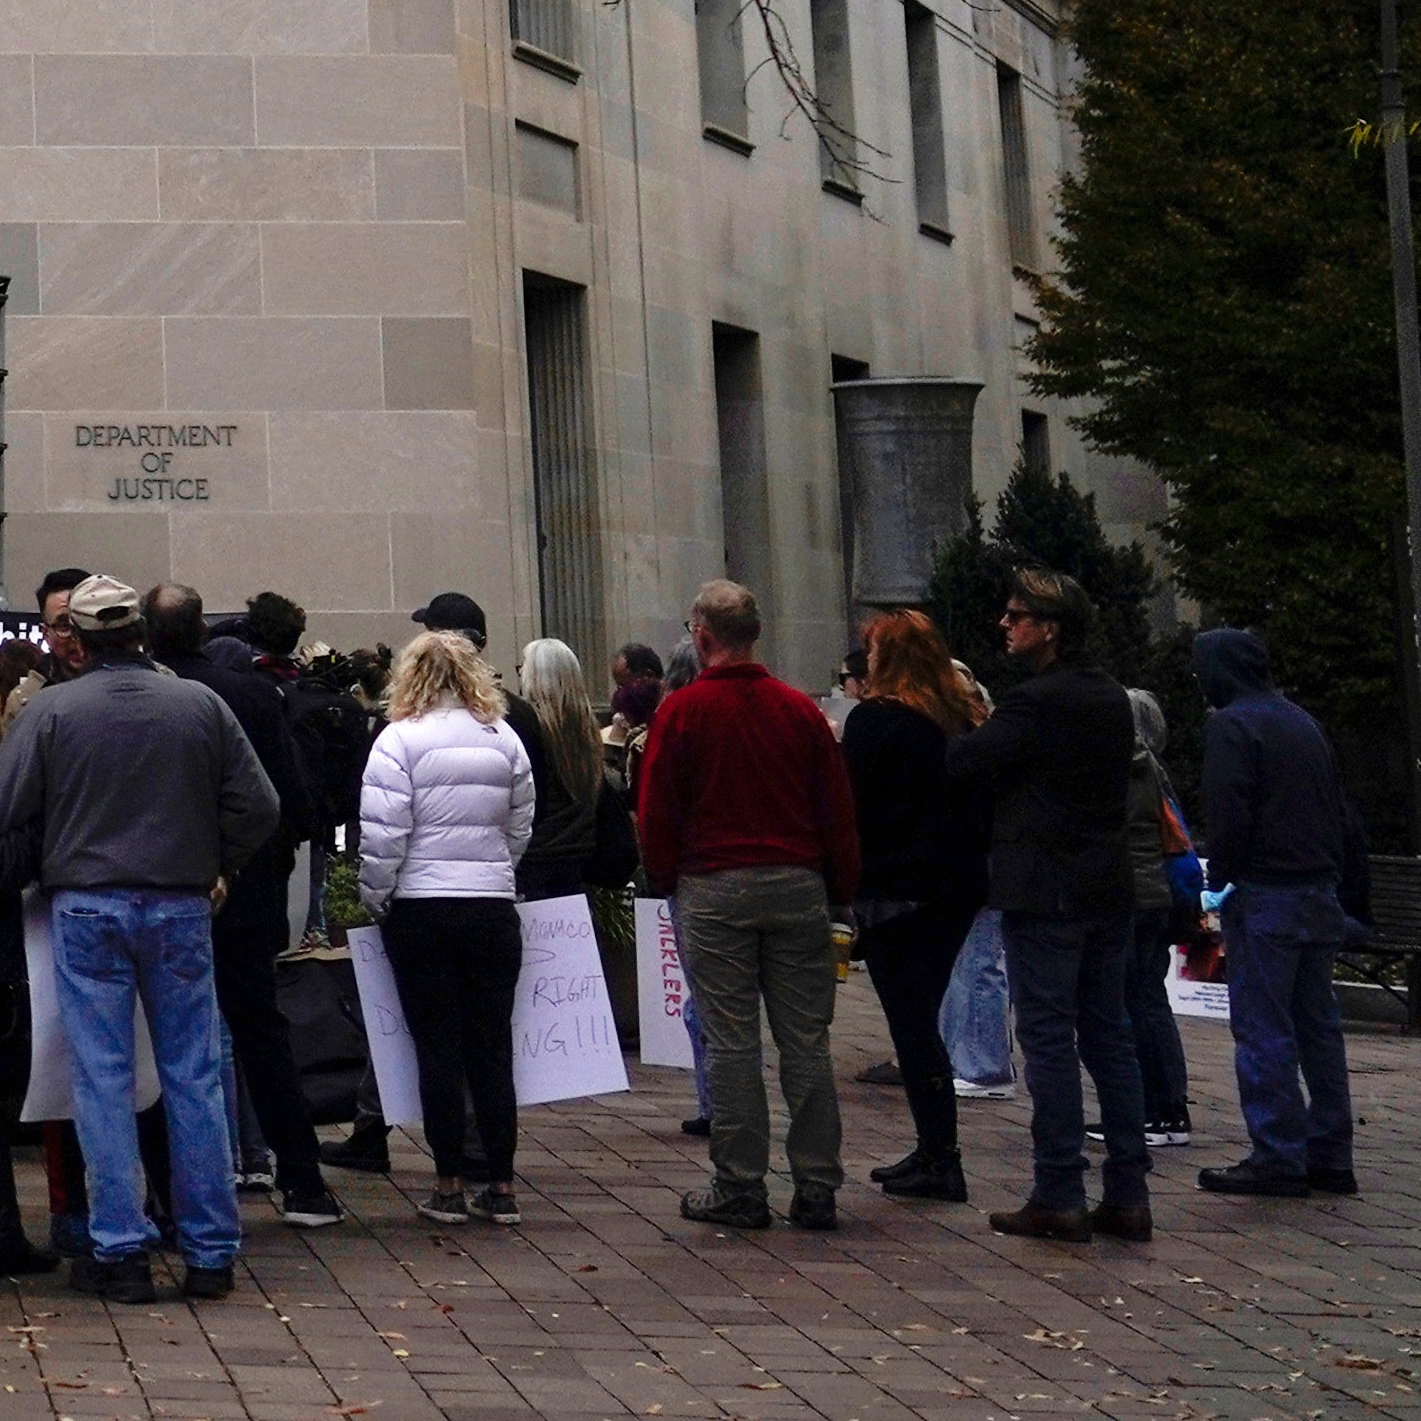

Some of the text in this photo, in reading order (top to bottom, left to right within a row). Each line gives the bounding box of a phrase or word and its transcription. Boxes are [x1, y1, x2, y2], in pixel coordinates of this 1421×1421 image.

[75, 425, 237, 447] DEPARTMENT
[140, 452, 174, 473] OF
[107, 478, 210, 500] JUSTICE
[532, 974, 602, 1008] RIGHT
